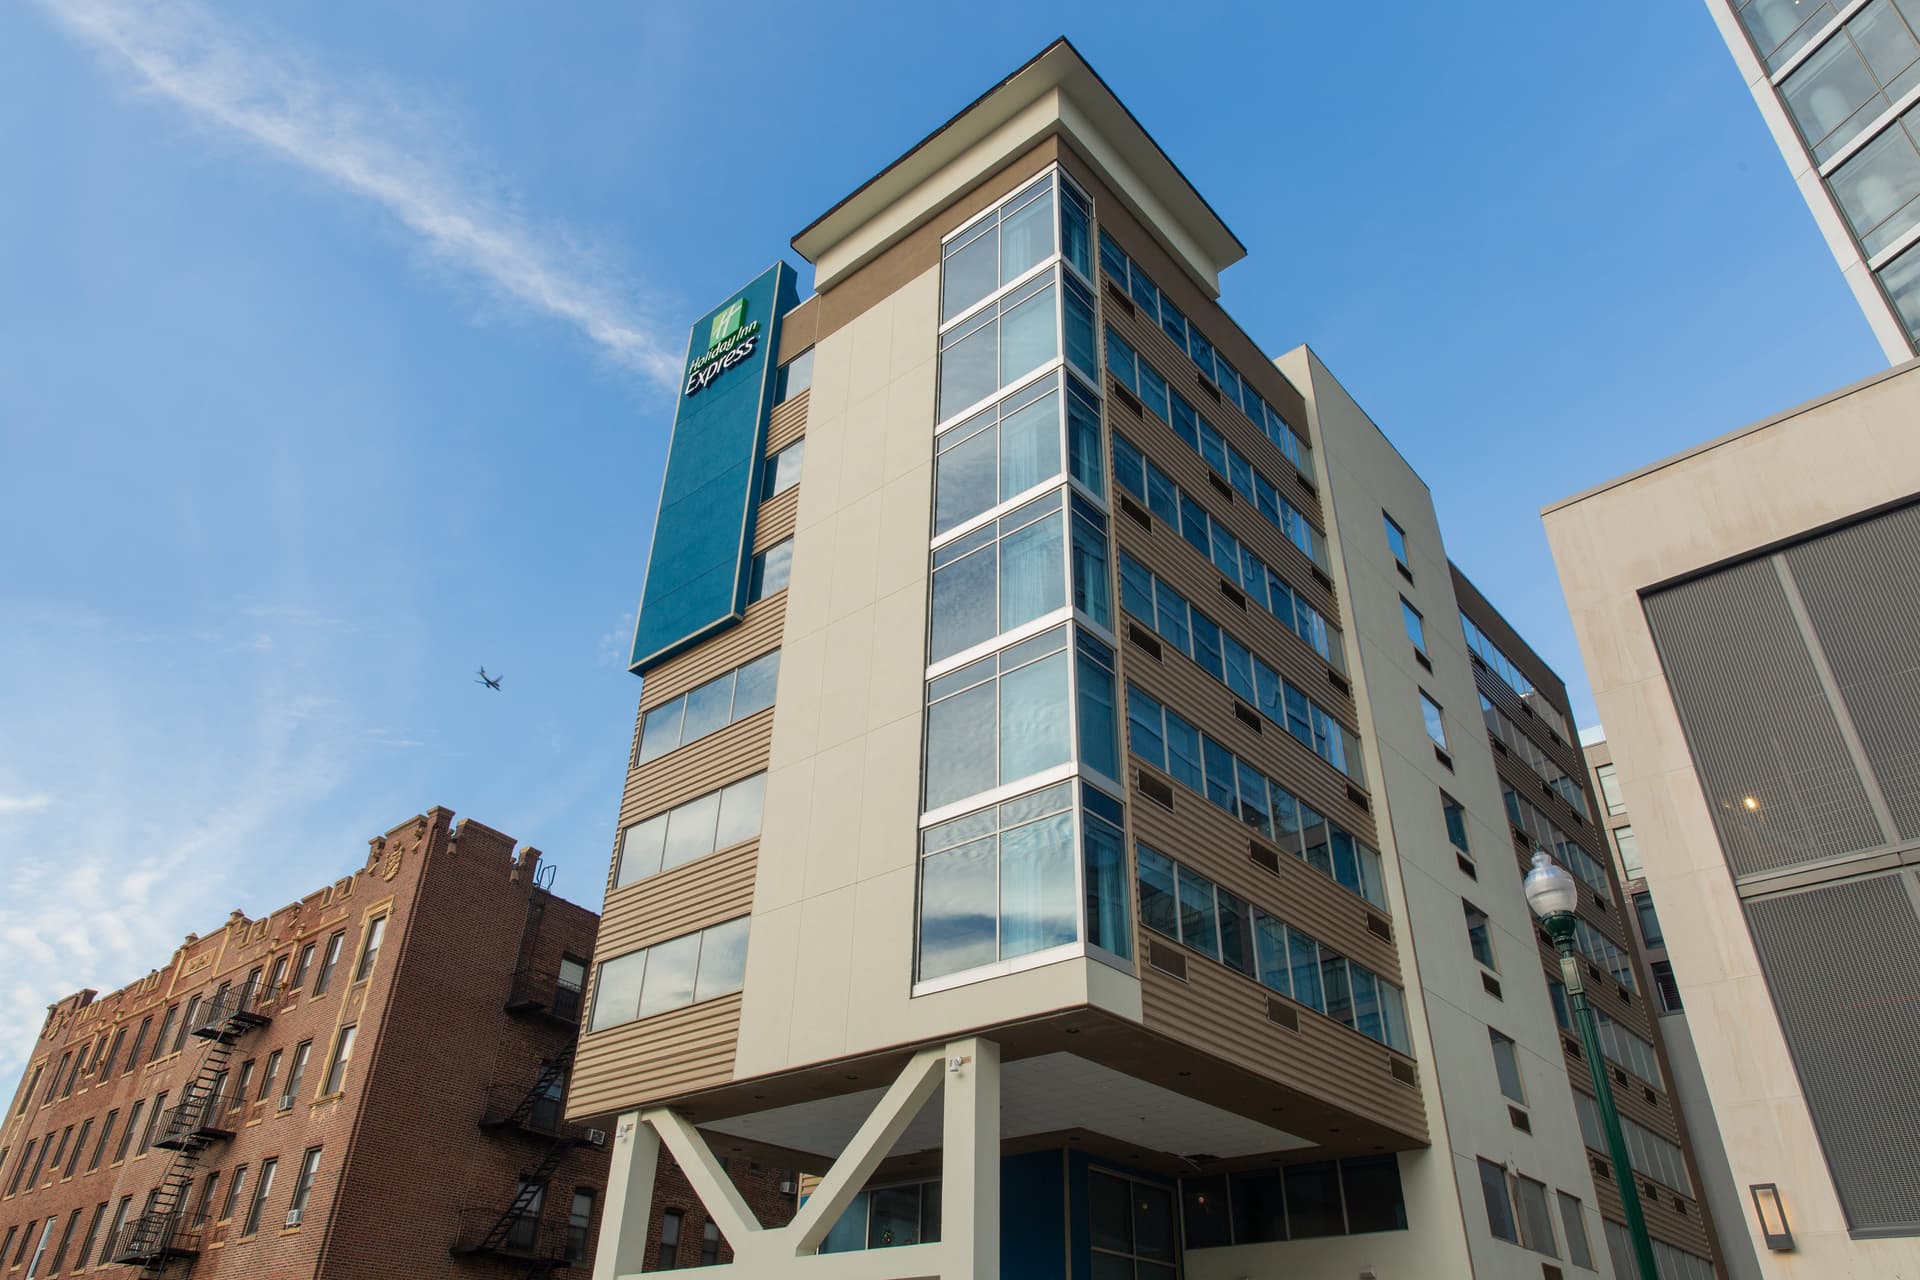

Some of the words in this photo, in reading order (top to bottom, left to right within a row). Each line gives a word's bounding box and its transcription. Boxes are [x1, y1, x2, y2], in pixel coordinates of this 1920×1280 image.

[685, 336, 755, 395] Express
[689, 335, 736, 374] Holiday
[736, 320, 758, 341] Inn
